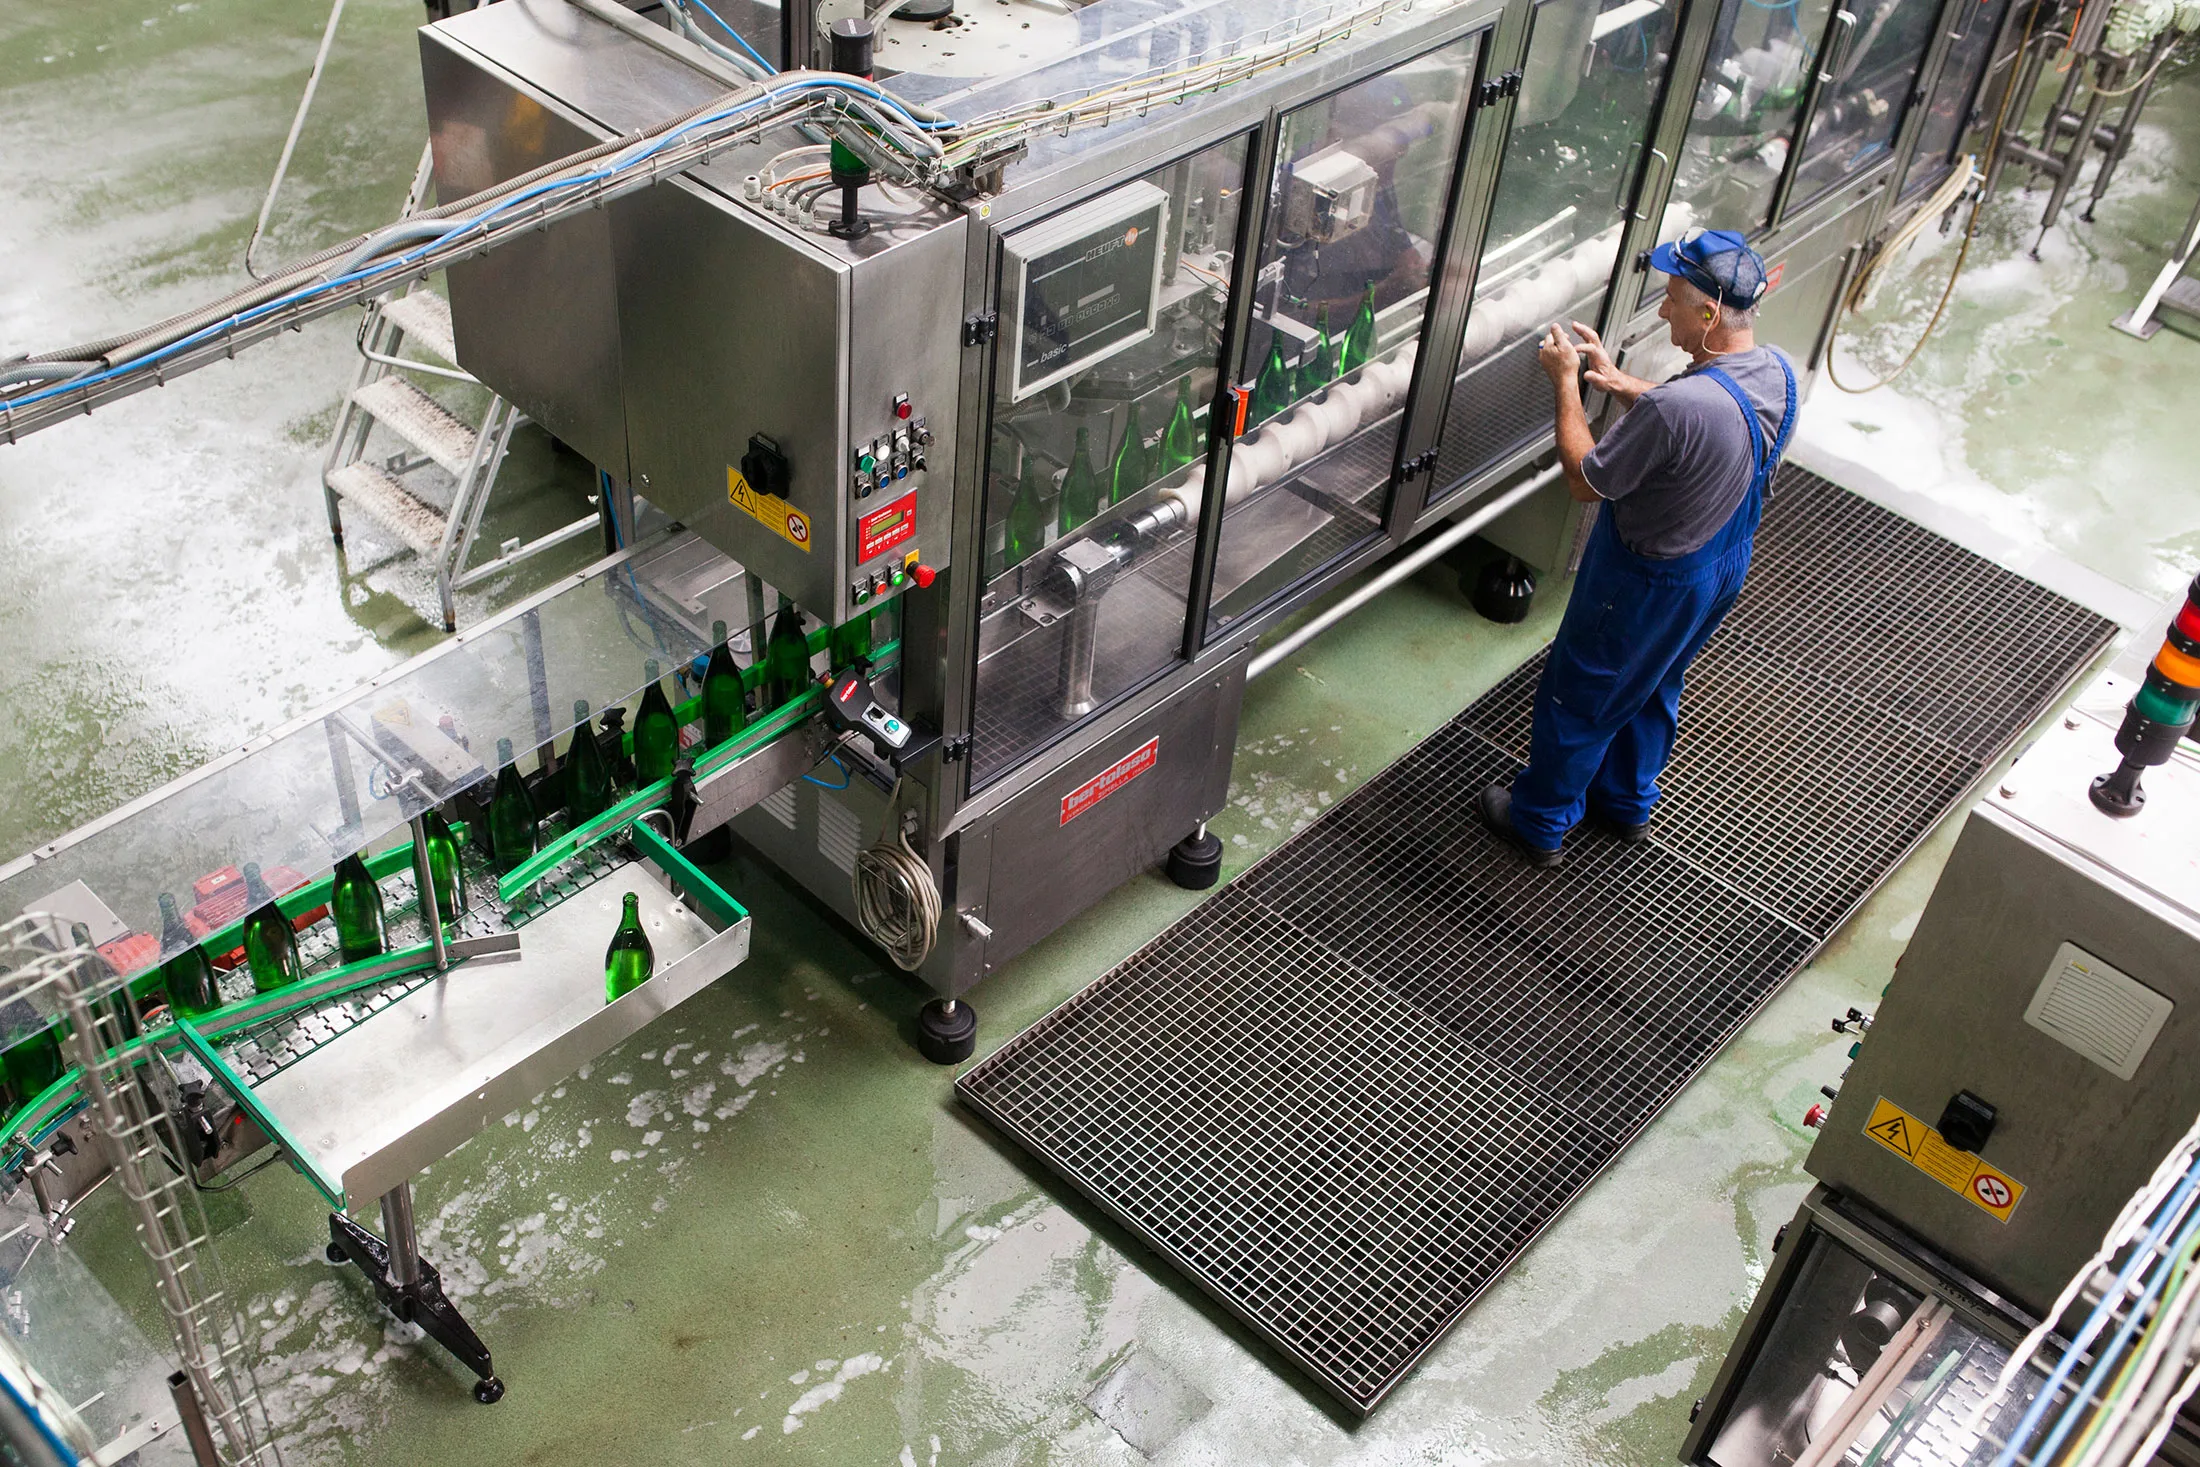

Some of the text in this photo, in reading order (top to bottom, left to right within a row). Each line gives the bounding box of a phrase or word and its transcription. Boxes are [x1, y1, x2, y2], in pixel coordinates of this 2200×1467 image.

[1085, 234, 1126, 262] HEUFT
[1040, 344, 1067, 363] basic
[1068, 748, 1151, 810] bertolaso
